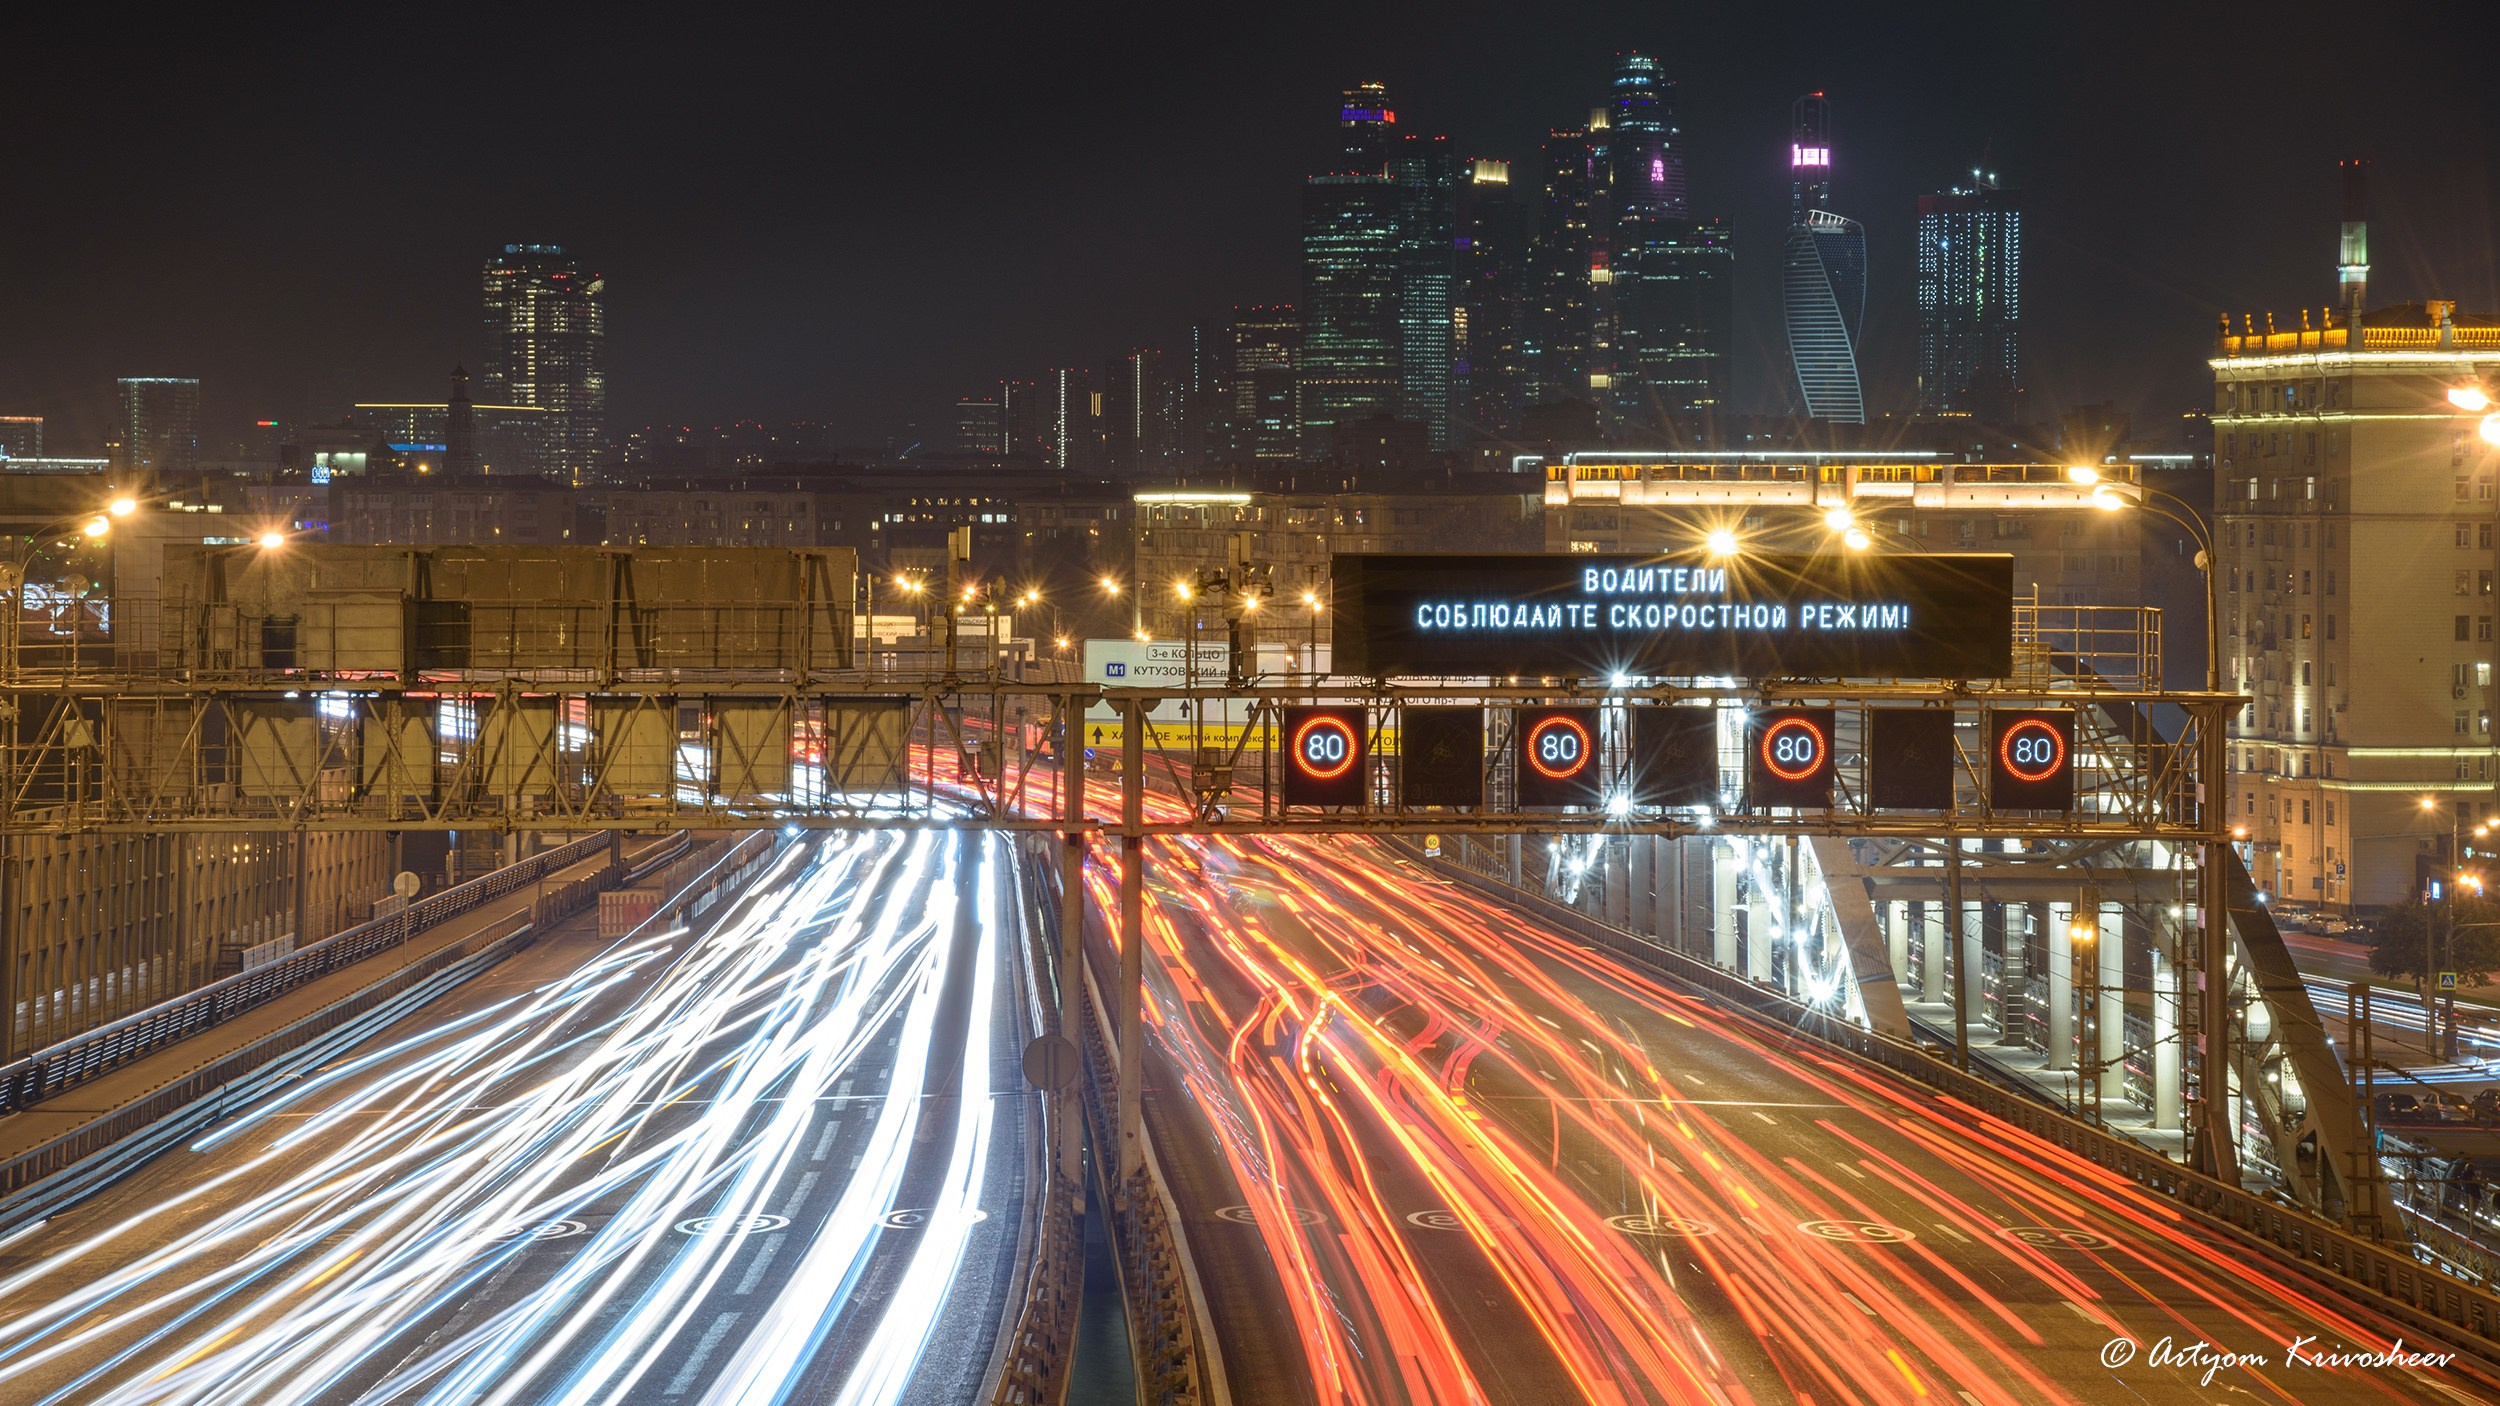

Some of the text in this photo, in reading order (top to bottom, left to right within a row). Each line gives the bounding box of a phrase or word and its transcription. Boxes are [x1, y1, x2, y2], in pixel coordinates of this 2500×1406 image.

[1585, 568, 1726, 593] ВОДИТЕЛИ
[1418, 603, 1908, 629] СОБЛЮДАЙТЕ СКОРОСТНОЙ РЕЖИМ!
[1152, 649, 1168, 658] 3-е
[1145, 731, 1170, 741] HDE
[1177, 733, 1210, 742] жилй
[1214, 734, 1264, 743] компекс
[1309, 735, 1344, 760] 80
[1543, 735, 1577, 760] 80
[1777, 737, 1811, 761] 80
[2016, 738, 2051, 762] 80
